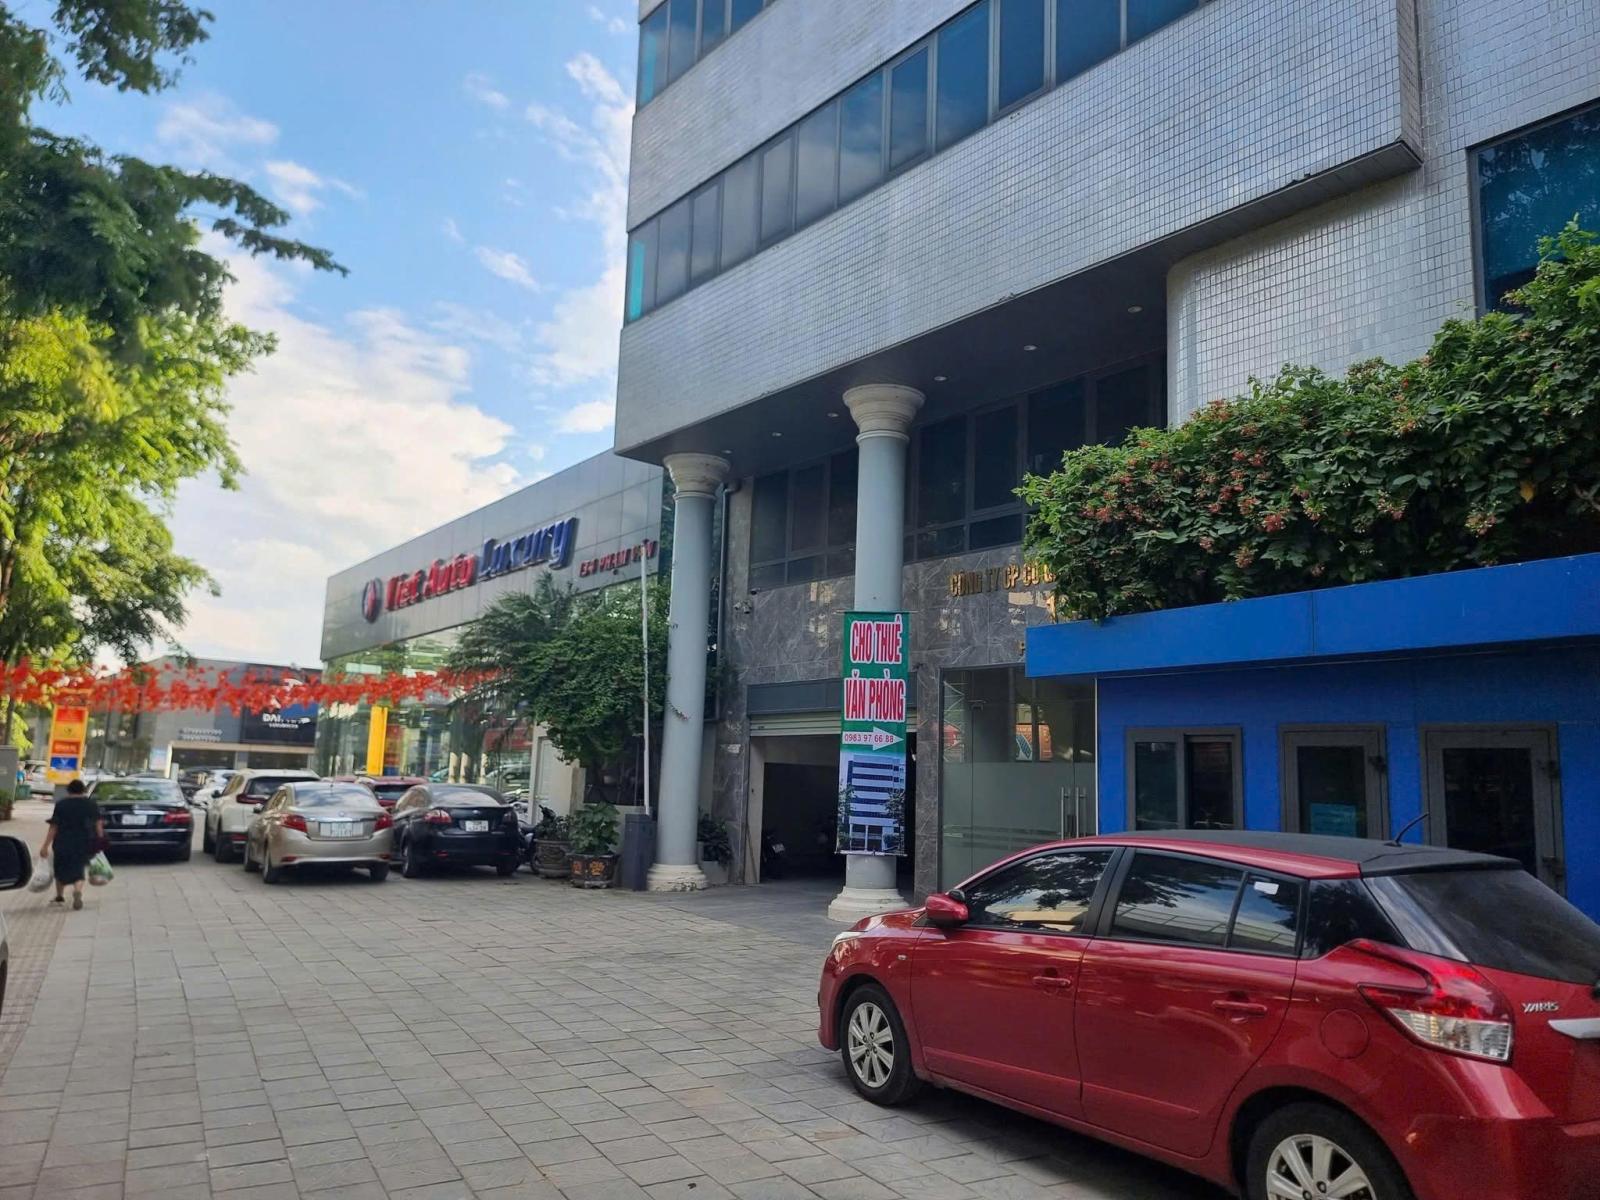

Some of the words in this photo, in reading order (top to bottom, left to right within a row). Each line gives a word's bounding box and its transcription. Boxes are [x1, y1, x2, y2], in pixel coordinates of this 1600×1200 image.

[478, 516, 577, 582] Luxury
[984, 567, 1001, 592] TY
[1003, 563, 1020, 589] CP
[851, 621, 874, 664] CHO
[875, 614, 902, 665] THUÊ
[844, 669, 867, 721] VĂN
[868, 669, 905, 723] PHÒNG
[863, 734, 872, 743] 97
[1521, 1001, 1560, 1013] YARIS
